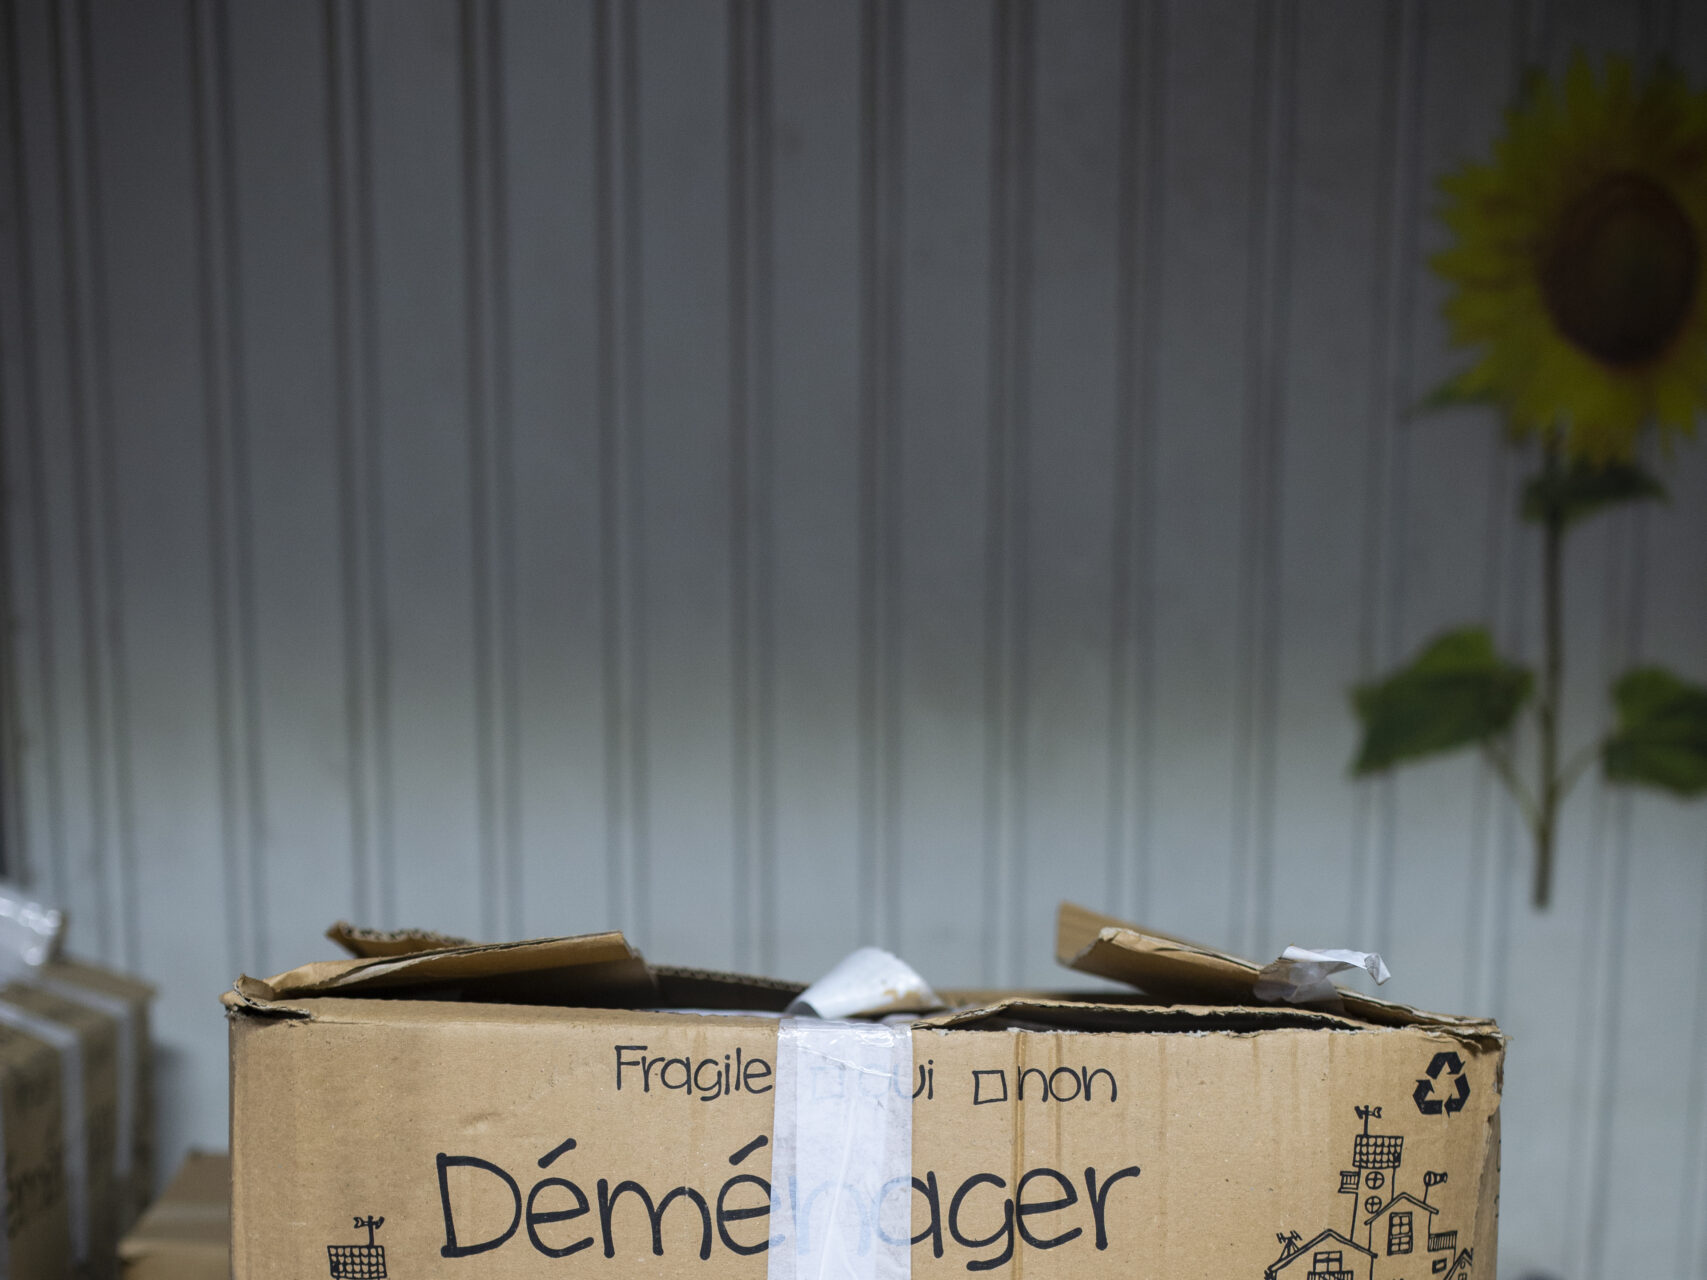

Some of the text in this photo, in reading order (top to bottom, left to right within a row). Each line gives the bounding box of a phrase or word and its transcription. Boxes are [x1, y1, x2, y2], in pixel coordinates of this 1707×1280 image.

[614, 1045, 773, 1102] Fragile
[1017, 1066, 1118, 1103] non
[437, 1135, 1141, 1272] Déménager
